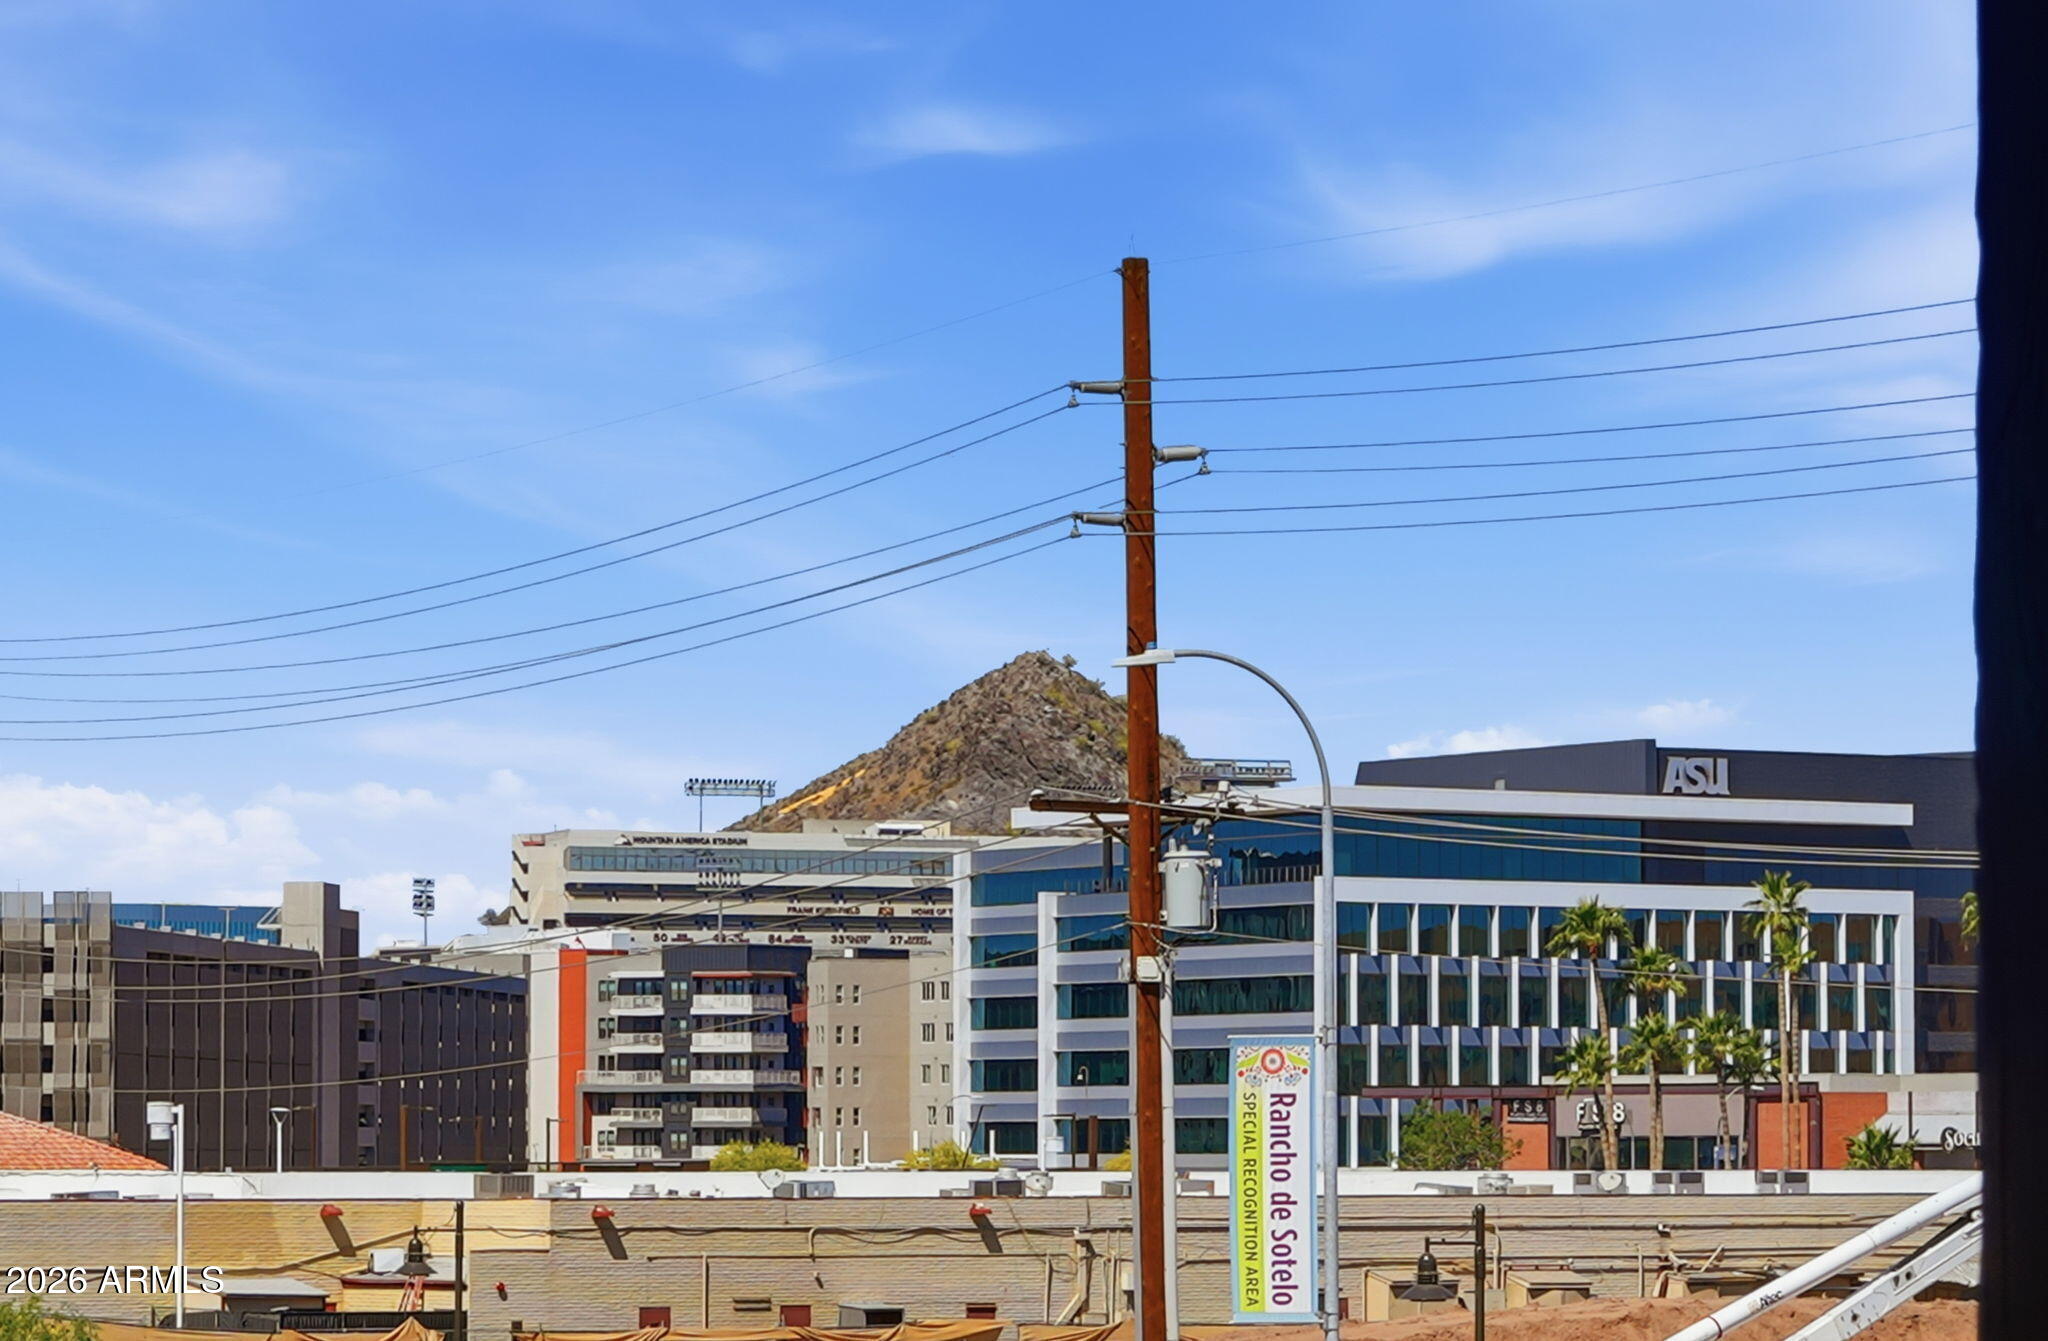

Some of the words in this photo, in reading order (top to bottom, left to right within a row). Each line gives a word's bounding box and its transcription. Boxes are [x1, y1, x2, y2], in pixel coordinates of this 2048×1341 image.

[1662, 756, 1730, 795] ASU
[632, 836, 673, 845] MOUNTAIN
[675, 837, 710, 845] AMERICA
[712, 837, 748, 846] STADIUM
[911, 907, 934, 915] HOME
[653, 932, 668, 942] 50
[768, 933, 783, 944] 84
[831, 934, 845, 945] 33
[889, 935, 903, 945] 27
[1242, 1092, 1257, 1154] SPECIAL
[1269, 1092, 1298, 1182] Rancho
[1243, 1158, 1259, 1261] RECOGNITION
[1270, 1192, 1298, 1220] de
[1270, 1229, 1299, 1306] Sotelo
[1244, 1267, 1260, 1307] AREA
